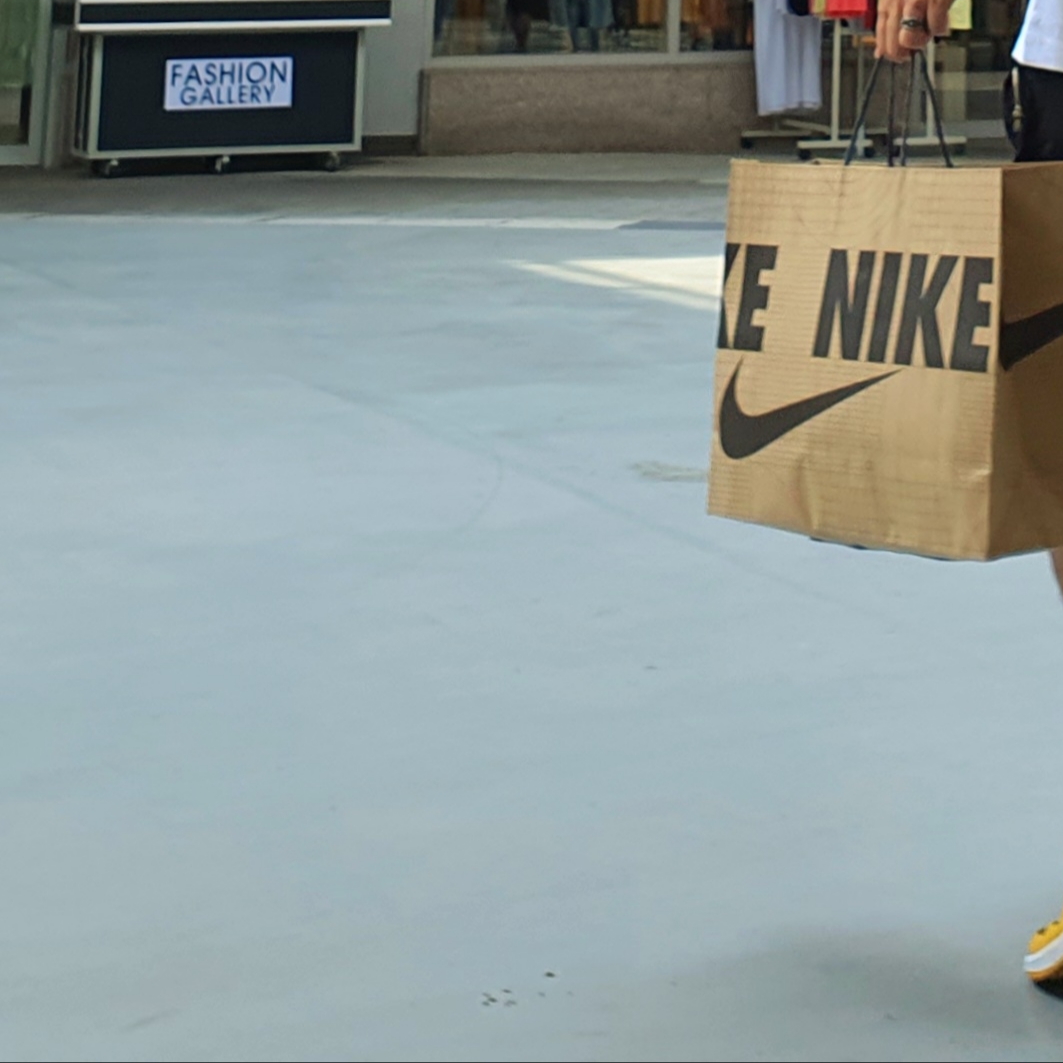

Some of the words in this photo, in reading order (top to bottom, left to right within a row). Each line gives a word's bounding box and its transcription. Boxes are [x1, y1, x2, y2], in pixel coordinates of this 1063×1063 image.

[171, 60, 288, 87] FASHION
[179, 83, 276, 106] GALLERY
[812, 248, 994, 373] NIKE
